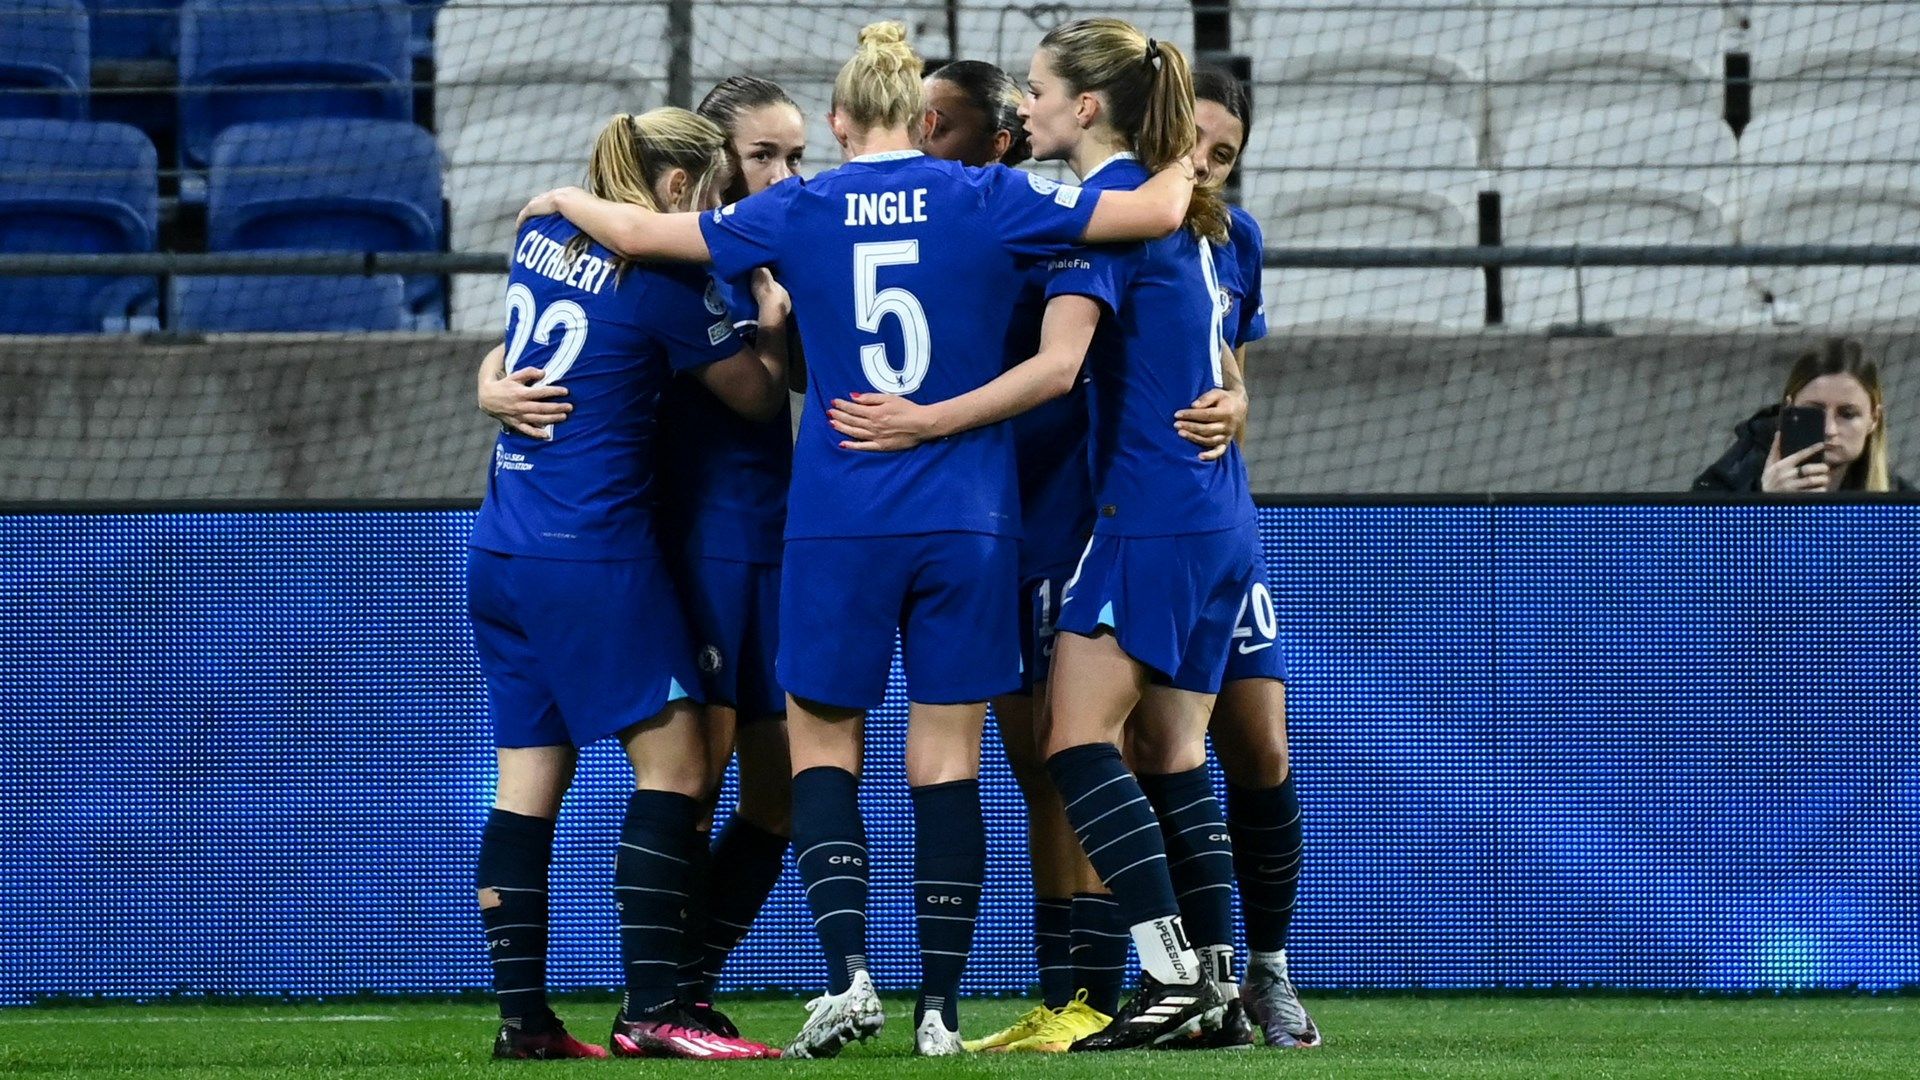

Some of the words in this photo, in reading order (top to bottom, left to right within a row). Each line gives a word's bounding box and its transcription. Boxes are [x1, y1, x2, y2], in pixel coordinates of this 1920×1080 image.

[844, 187, 928, 226] INGLE
[853, 239, 931, 396] 5
[828, 855, 863, 866] CFC
[926, 895, 963, 905] CFC
